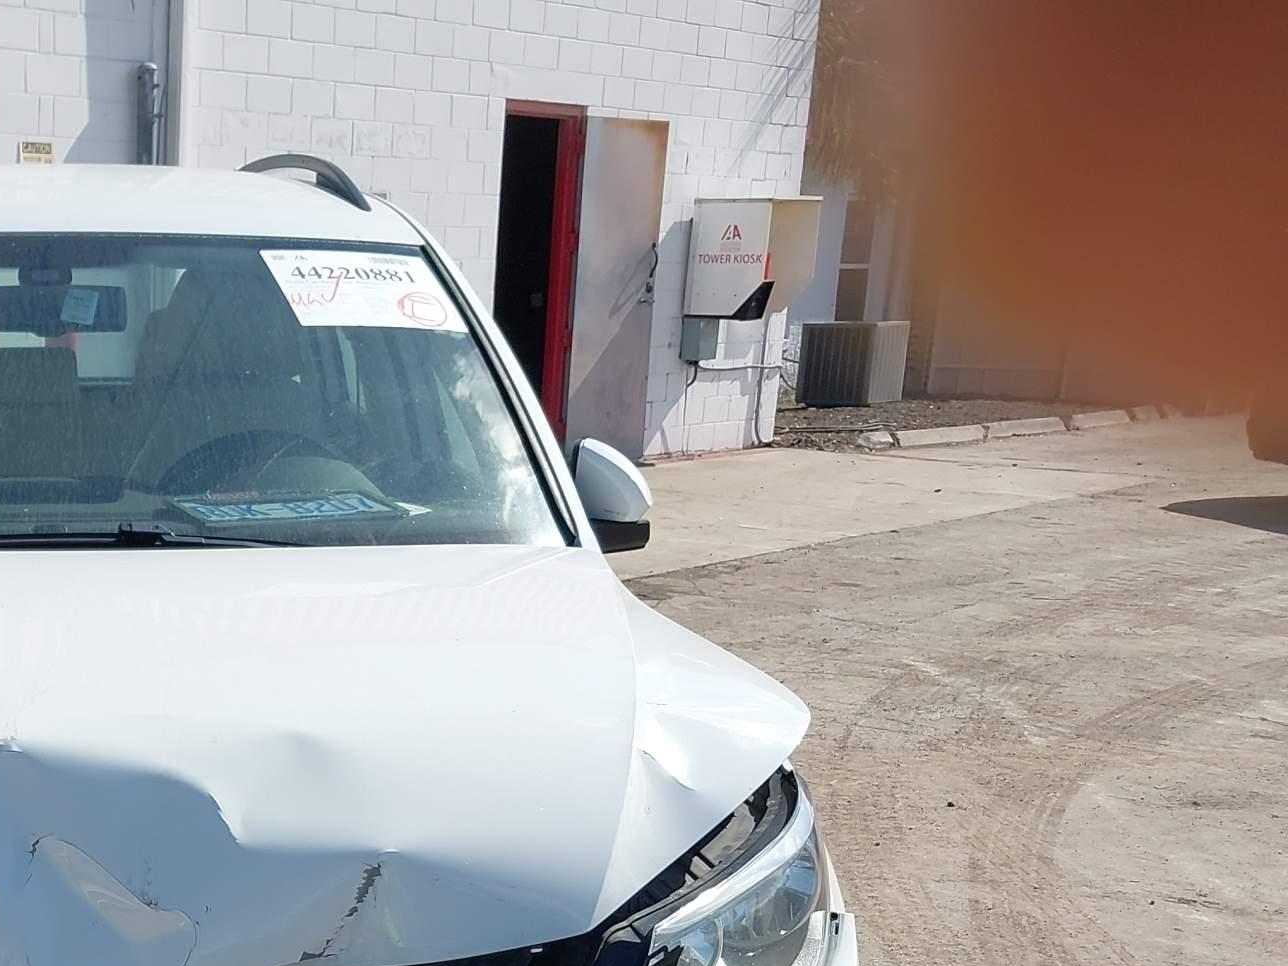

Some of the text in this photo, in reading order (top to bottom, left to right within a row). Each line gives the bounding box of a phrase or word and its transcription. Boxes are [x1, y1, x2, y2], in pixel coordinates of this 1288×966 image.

[23, 143, 51, 153] CAUTION
[698, 253, 762, 264] TOWER KIOSK
[290, 264, 416, 284] 44220881
